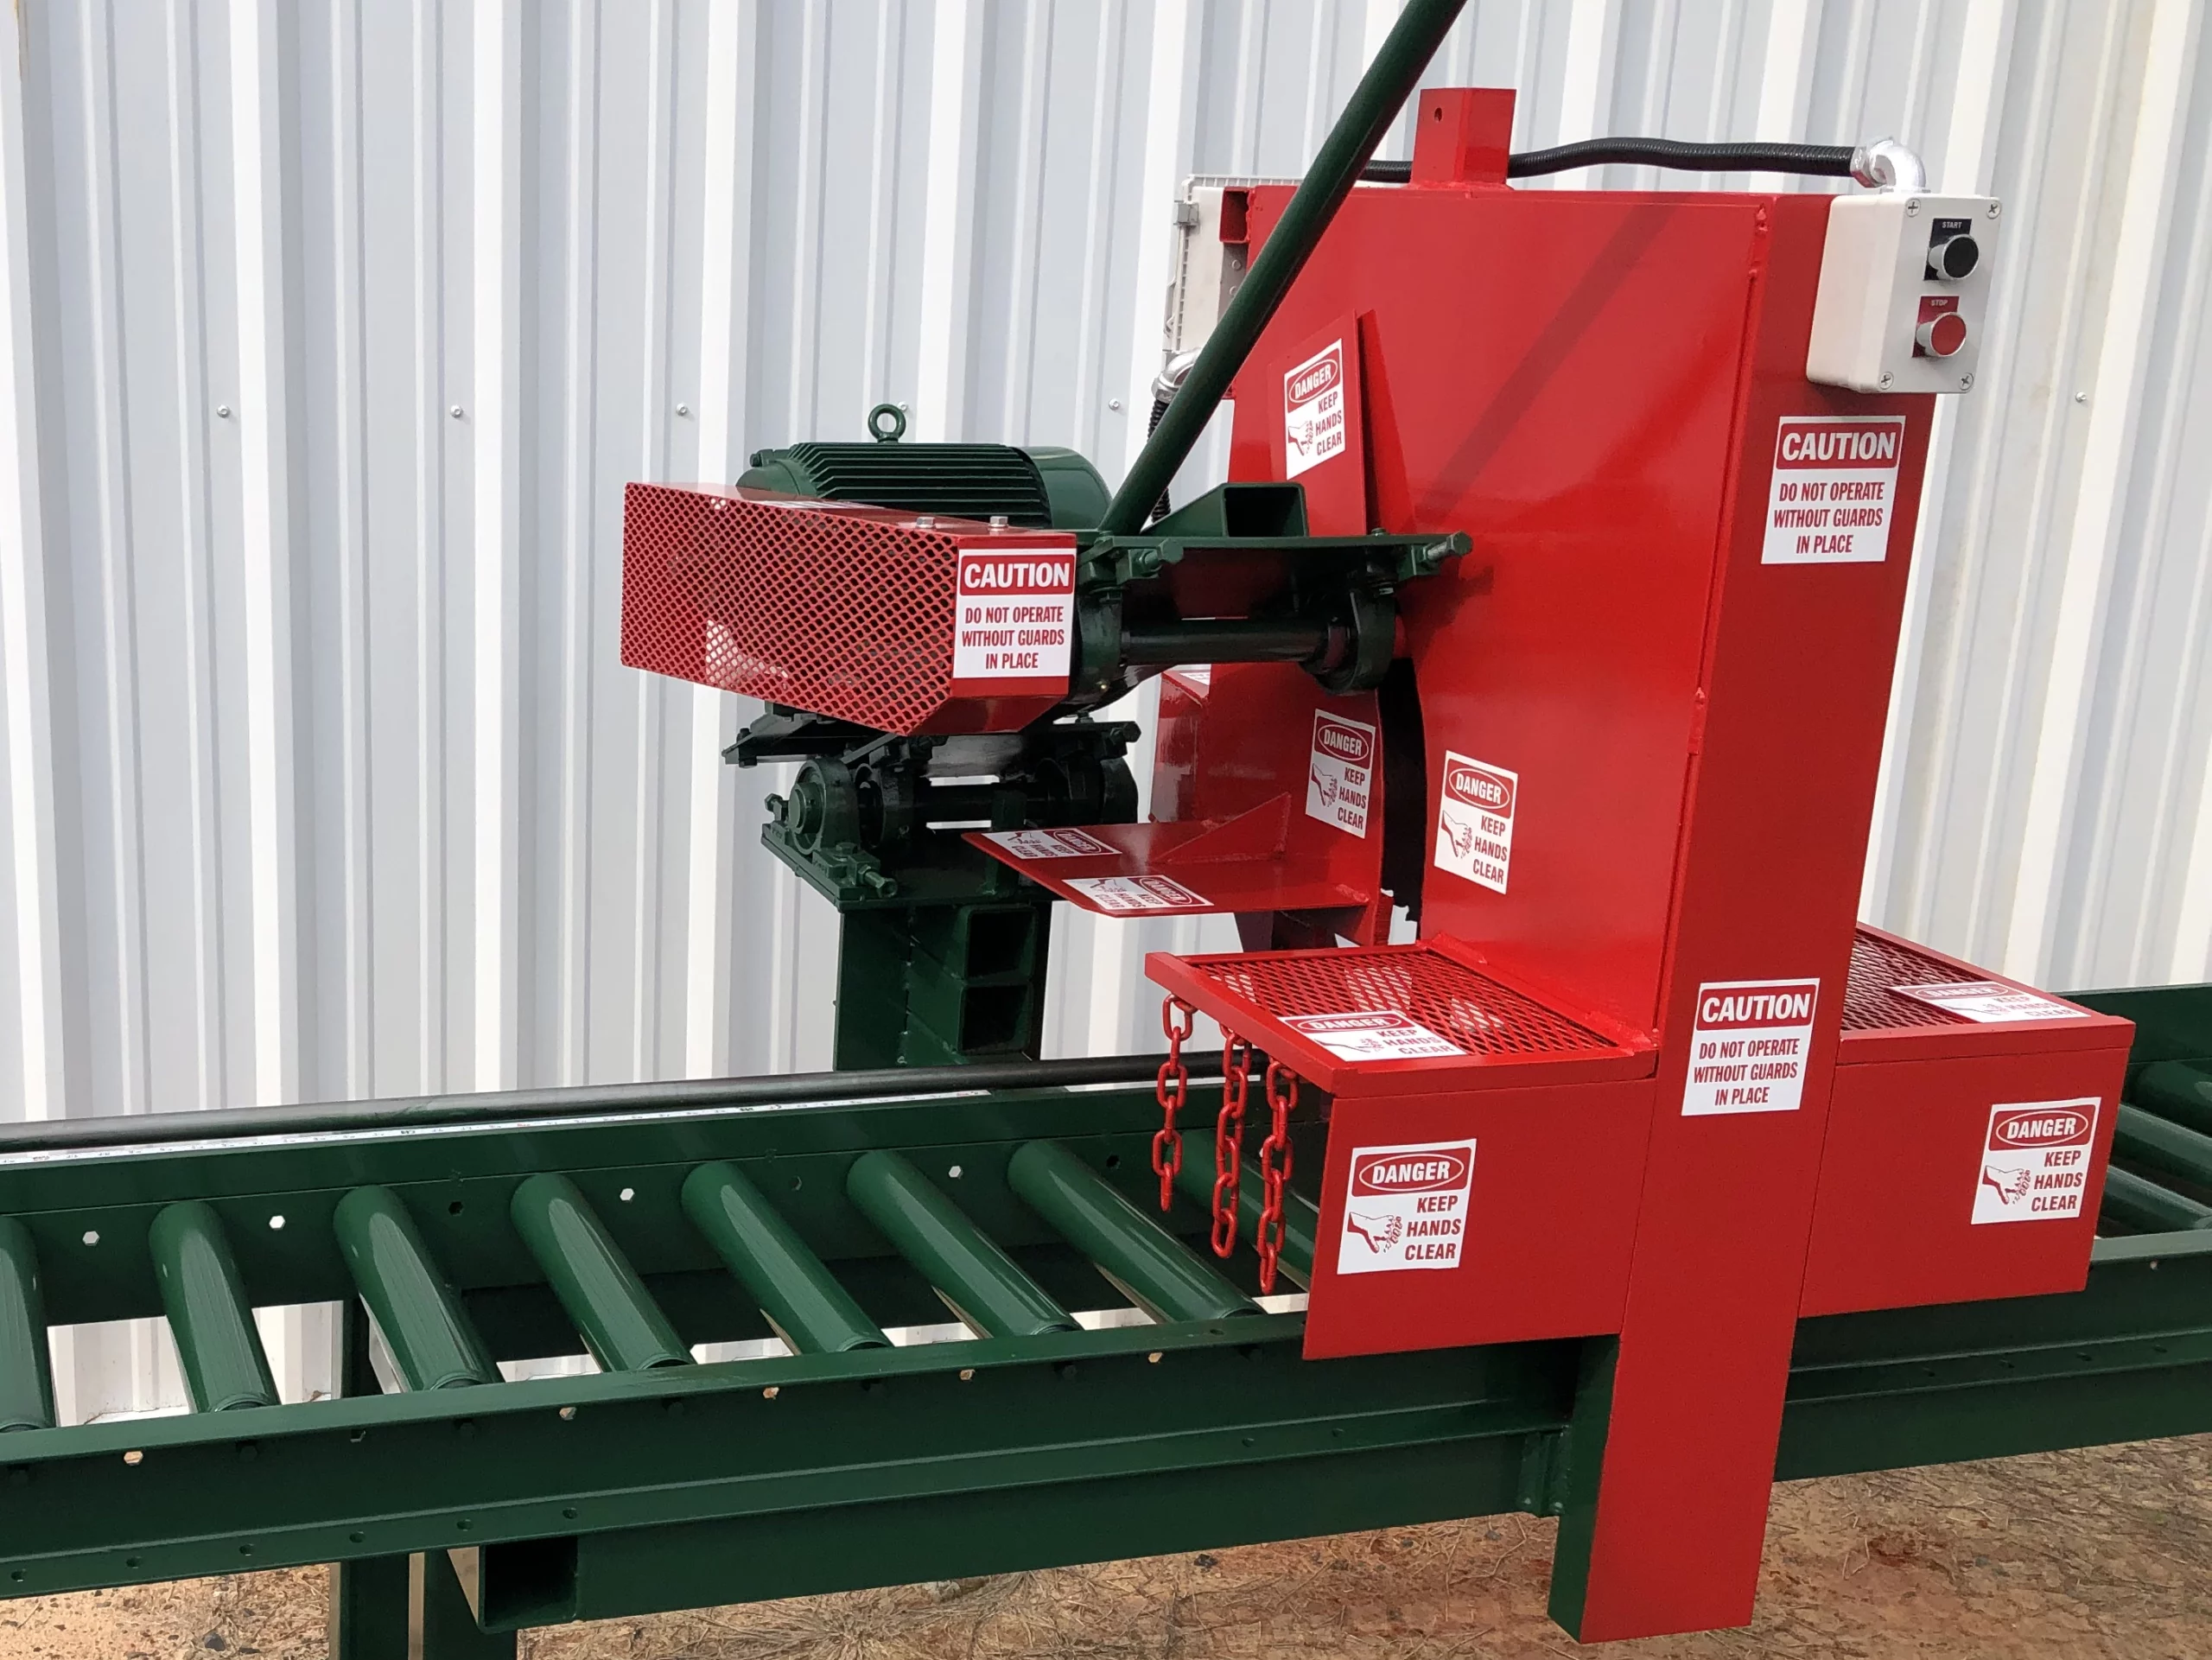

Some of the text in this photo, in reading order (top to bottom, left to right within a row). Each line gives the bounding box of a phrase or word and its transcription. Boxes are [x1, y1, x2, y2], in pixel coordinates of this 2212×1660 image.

[1294, 364, 1332, 399] DANGER
[1319, 391, 1338, 414] KEEP
[1315, 410, 1342, 436] HANDS
[1317, 431, 1342, 455] CLEAR
[1783, 432, 1896, 461] CAUTION
[1779, 482, 1885, 501] DO NOT OPERATE
[1774, 508, 1883, 528] WITHOUT GUARDS
[1796, 535, 1853, 553] IN PLACE
[964, 563, 1070, 588] CAUTION
[965, 607, 1064, 624] DO NOT OPERATE
[963, 629, 1065, 646] WITHOUT GUARDS
[986, 652, 1039, 670] IN PLACE
[1324, 728, 1362, 756] DANGER
[1344, 767, 1365, 786] KEEP
[1338, 786, 1366, 809] HANDS
[1456, 773, 1502, 804] DANGER
[1338, 807, 1363, 830] CLEAR
[1481, 815, 1505, 836] KEEP
[1012, 846, 1039, 857] CLEAR
[1029, 844, 1058, 856] HANDS
[1050, 844, 1074, 855] KEEP
[1058, 833, 1097, 851] DANGER
[1475, 836, 1507, 862] HANDS
[1473, 859, 1503, 884] CLEAR
[1095, 894, 1125, 907] CLEAR
[1114, 893, 1147, 907] HANDS
[1137, 894, 1164, 905] KEEP
[1145, 881, 1187, 902] DANGER
[1702, 994, 1811, 1022] CAUTION
[1308, 1017, 1388, 1030] DANGER
[1376, 1029, 1417, 1038] KEEP
[1384, 1037, 1442, 1046] HANDS
[1399, 1046, 1454, 1055] CLEAR
[1700, 1039, 1800, 1059] DO NOT OPERATE
[1694, 1062, 1798, 1084] WITHOUT GUARDS
[1715, 1087, 1770, 1105] IN PLACE
[2007, 1117, 2076, 1140] DANGER
[2044, 1150, 2081, 1167] KEEP
[1372, 1161, 1450, 1184] DANGER
[2034, 1173, 2083, 1190] HANDS
[1417, 1195, 1458, 1213] KEEP
[2031, 1195, 2077, 1212] CLEAR
[1407, 1218, 1461, 1237] HANDS
[1405, 1243, 1456, 1260] CLEAR
